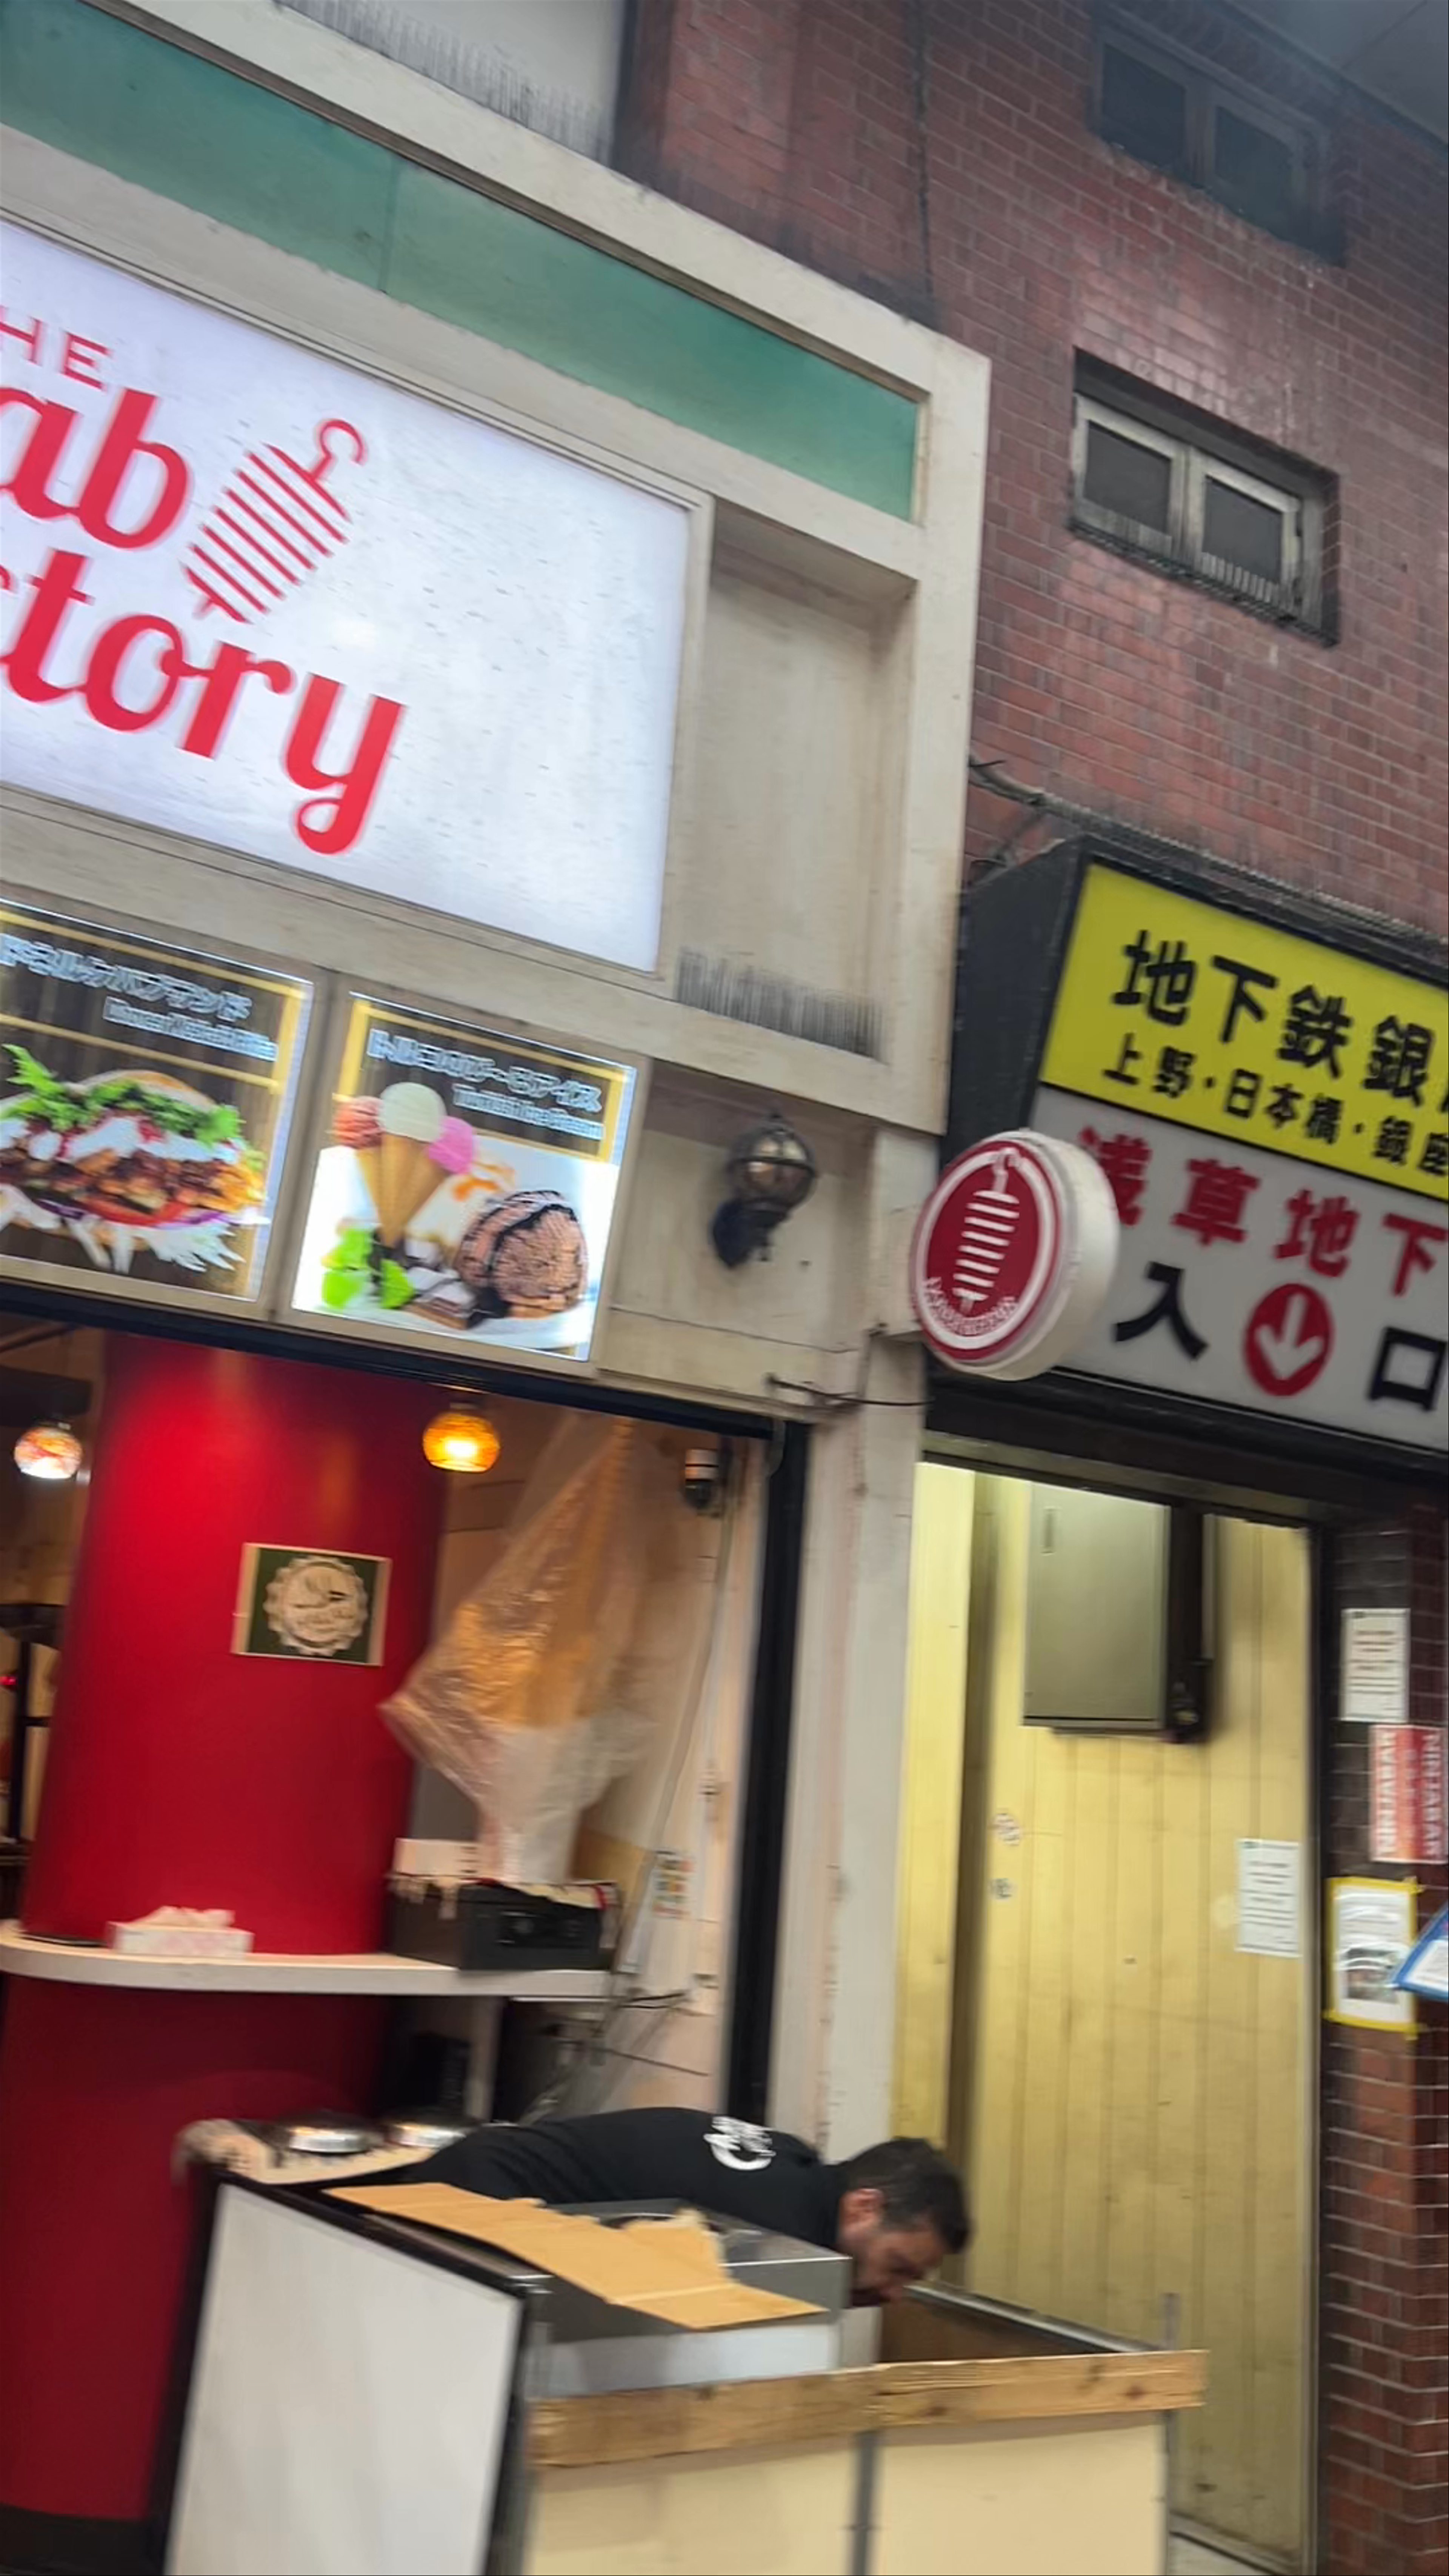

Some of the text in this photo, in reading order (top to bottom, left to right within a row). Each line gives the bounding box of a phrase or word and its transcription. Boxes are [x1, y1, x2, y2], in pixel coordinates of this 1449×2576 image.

[0, 548, 408, 855] tory
[1111, 929, 1448, 1112] 地下鉄銀
